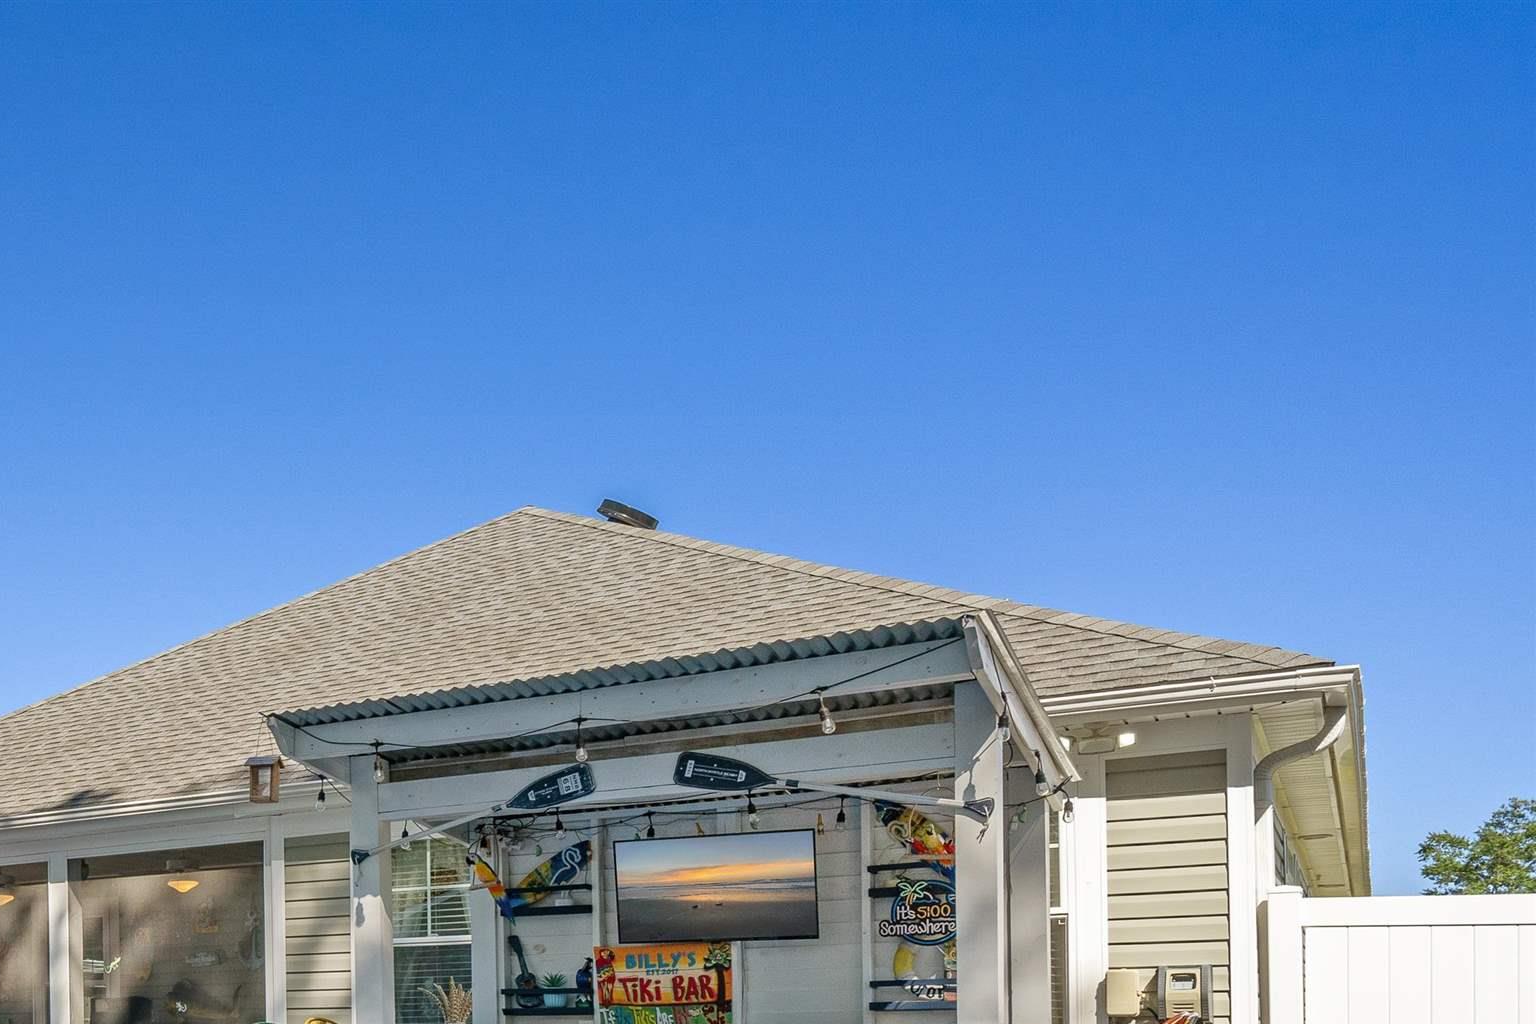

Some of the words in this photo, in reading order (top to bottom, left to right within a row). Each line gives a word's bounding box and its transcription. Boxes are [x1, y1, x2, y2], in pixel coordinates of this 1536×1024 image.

[896, 905, 916, 920] It's
[880, 919, 957, 936] Somewhere
[625, 952, 696, 969] BILLY'S
[671, 975, 716, 1001] BAR
